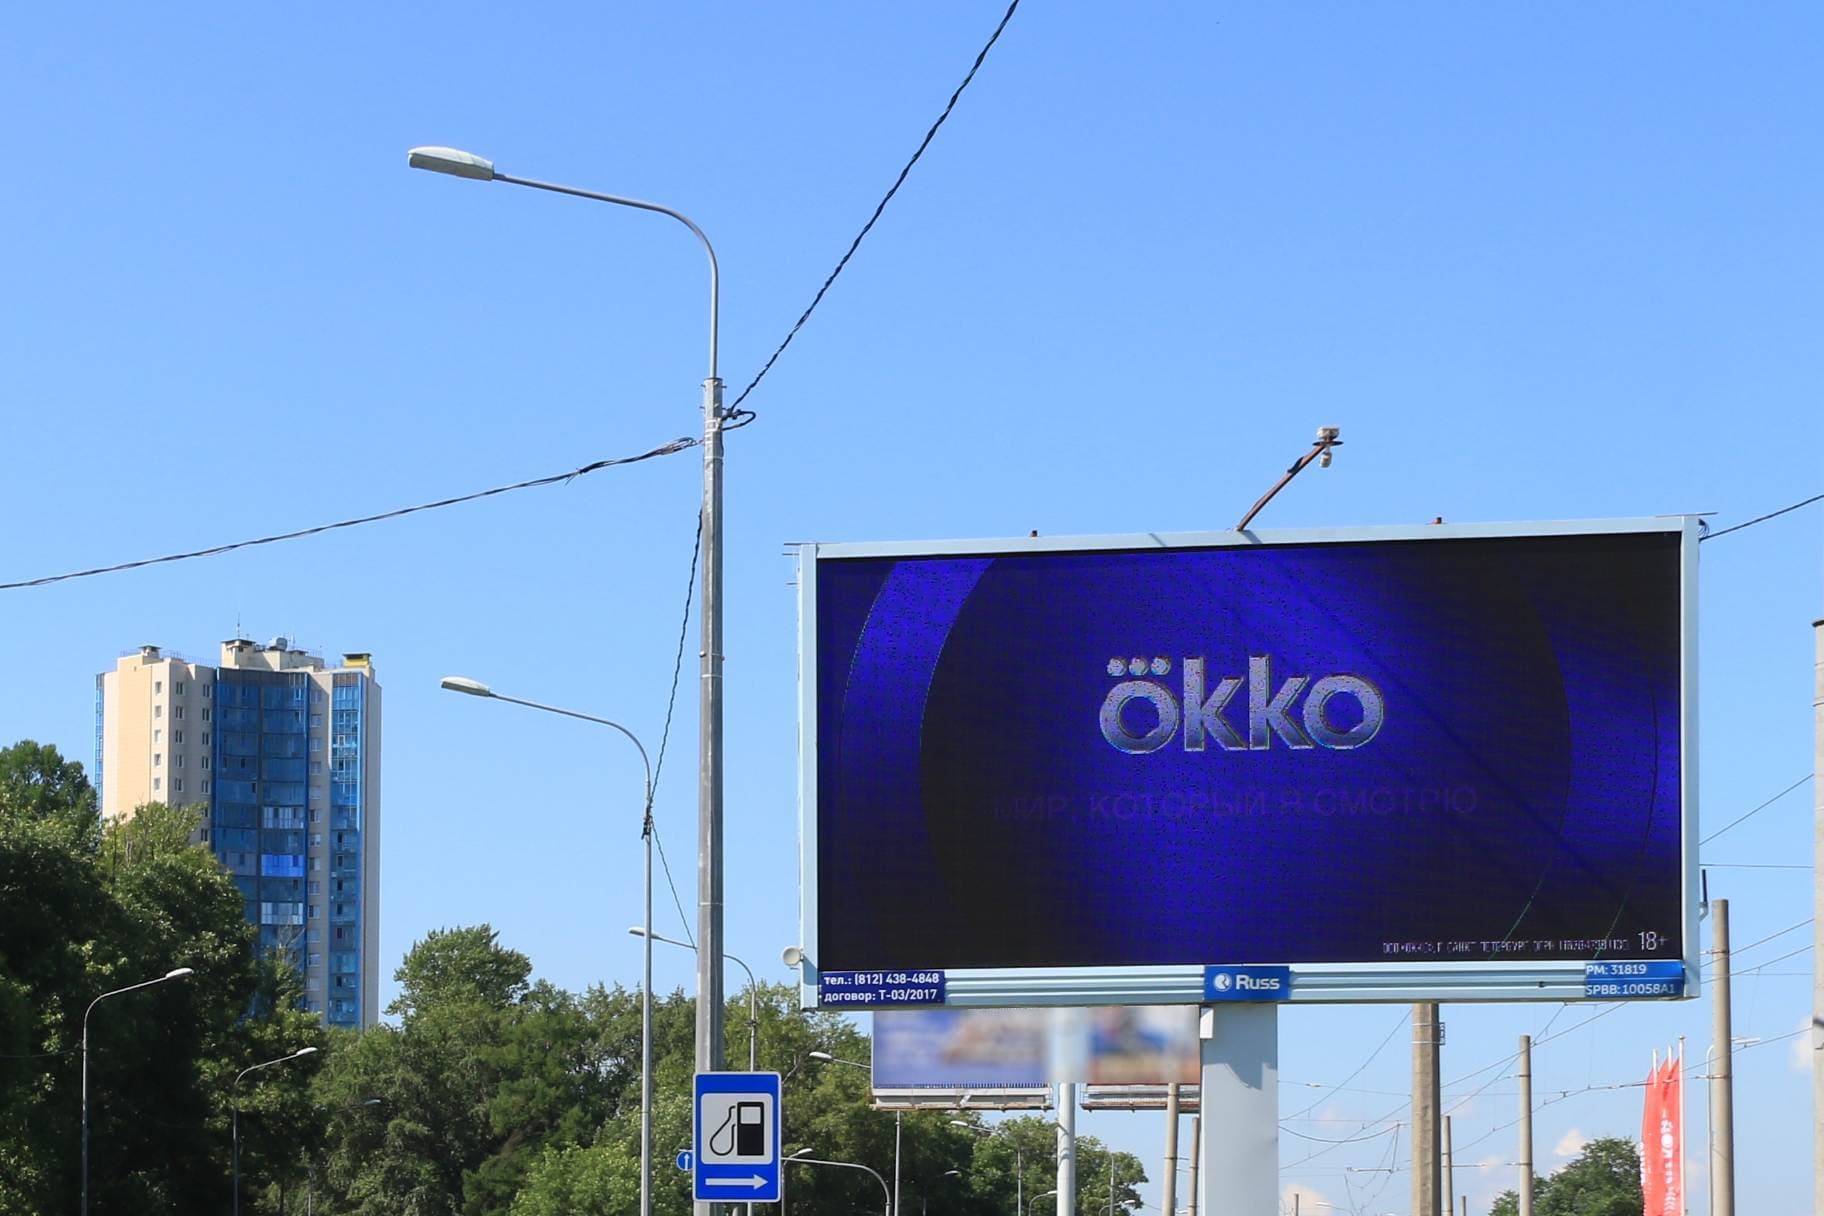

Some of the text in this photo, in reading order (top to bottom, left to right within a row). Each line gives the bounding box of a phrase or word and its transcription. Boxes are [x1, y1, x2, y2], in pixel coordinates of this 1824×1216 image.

[1638, 931, 1669, 951] 18+
[1610, 963, 1647, 975] 31819
[824, 972, 939, 985] тел.: (812) 438-4848
[1235, 974, 1280, 990] Russ
[824, 988, 937, 1003] договор: Т-03/2017
